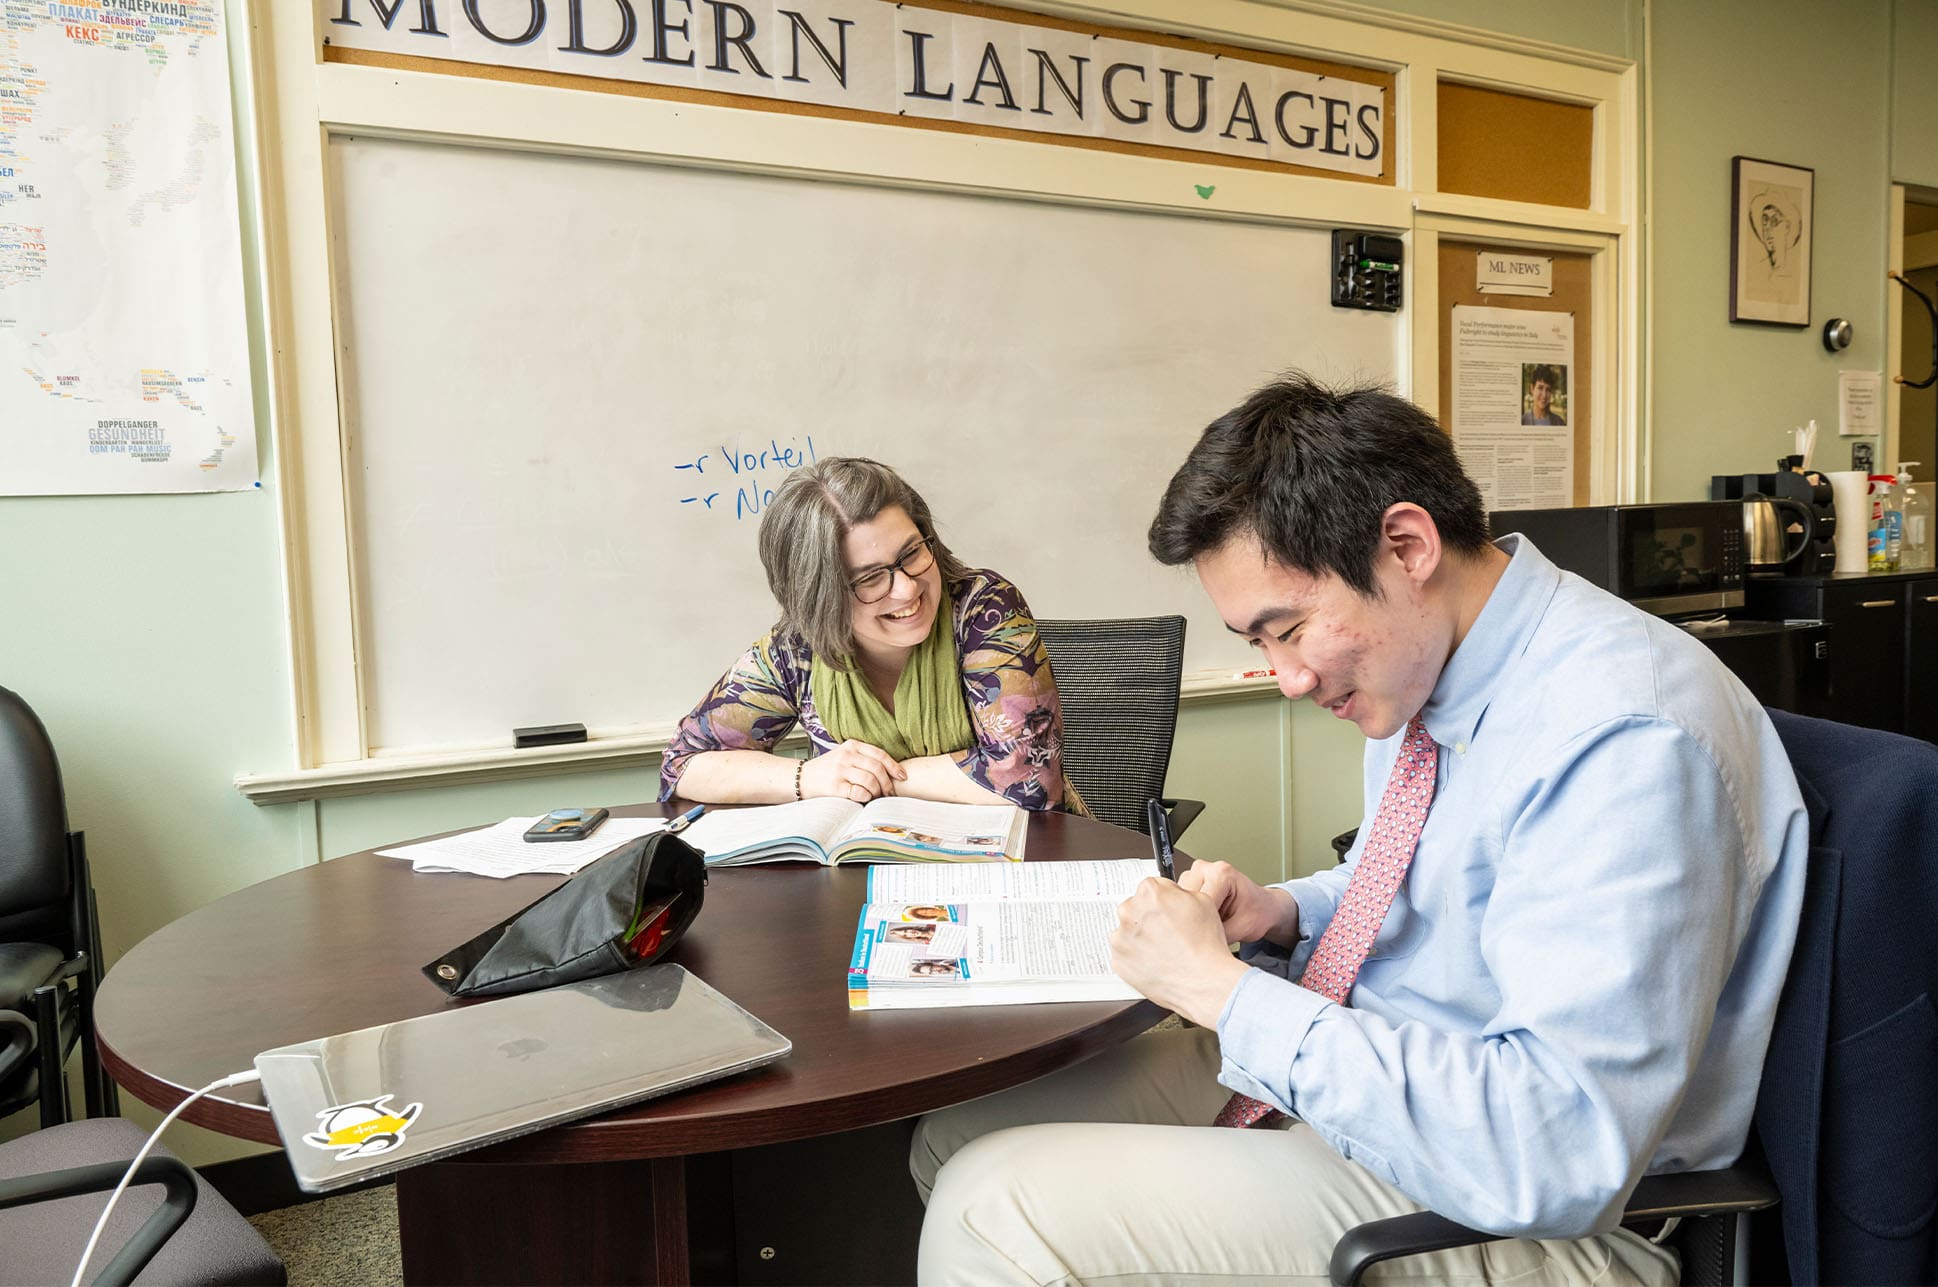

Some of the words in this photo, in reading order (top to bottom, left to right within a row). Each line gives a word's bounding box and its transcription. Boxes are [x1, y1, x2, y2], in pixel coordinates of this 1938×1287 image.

[48, 3, 99, 21] ПЛАКАТ
[103, 0, 187, 18] ВУНДЕРКИНД
[149, 15, 185, 26] СЛЕСАРЬ
[66, 25, 99, 41] КЕКС
[116, 31, 155, 42] АГРЕССОР
[902, 29, 1380, 160] LANGUAGES
[1488, 260, 1506, 274] ML
[1509, 262, 1540, 276] NEWS
[88, 428, 166, 440] GESUNDHEIT
[721, 435, 817, 474] Vorteil
